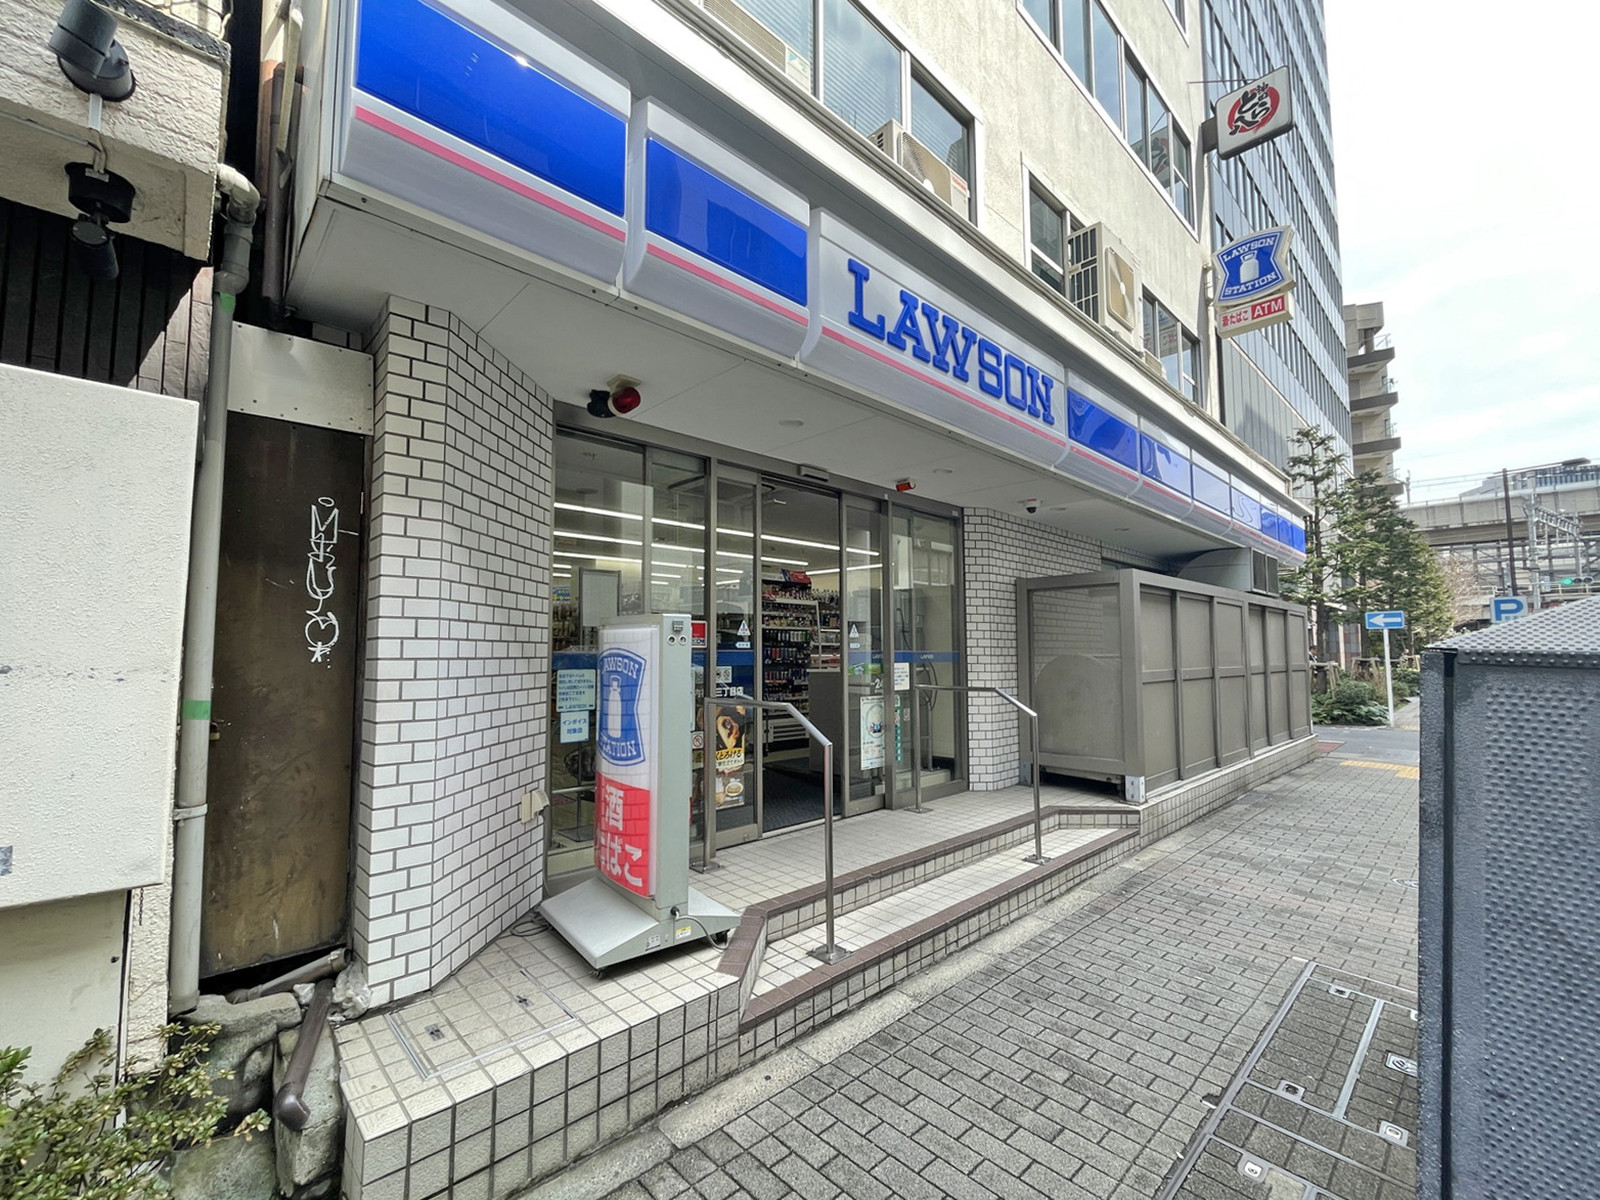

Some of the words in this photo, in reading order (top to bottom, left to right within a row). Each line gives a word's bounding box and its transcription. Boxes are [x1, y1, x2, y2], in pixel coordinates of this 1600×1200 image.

[1222, 236, 1276, 262] LAWSON
[1224, 272, 1278, 296] STATION
[1253, 298, 1283, 318] ATM
[848, 258, 1055, 425] LAWSON
[1494, 599, 1524, 621] P
[600, 656, 639, 680] AWSON
[605, 784, 625, 831] 酒
